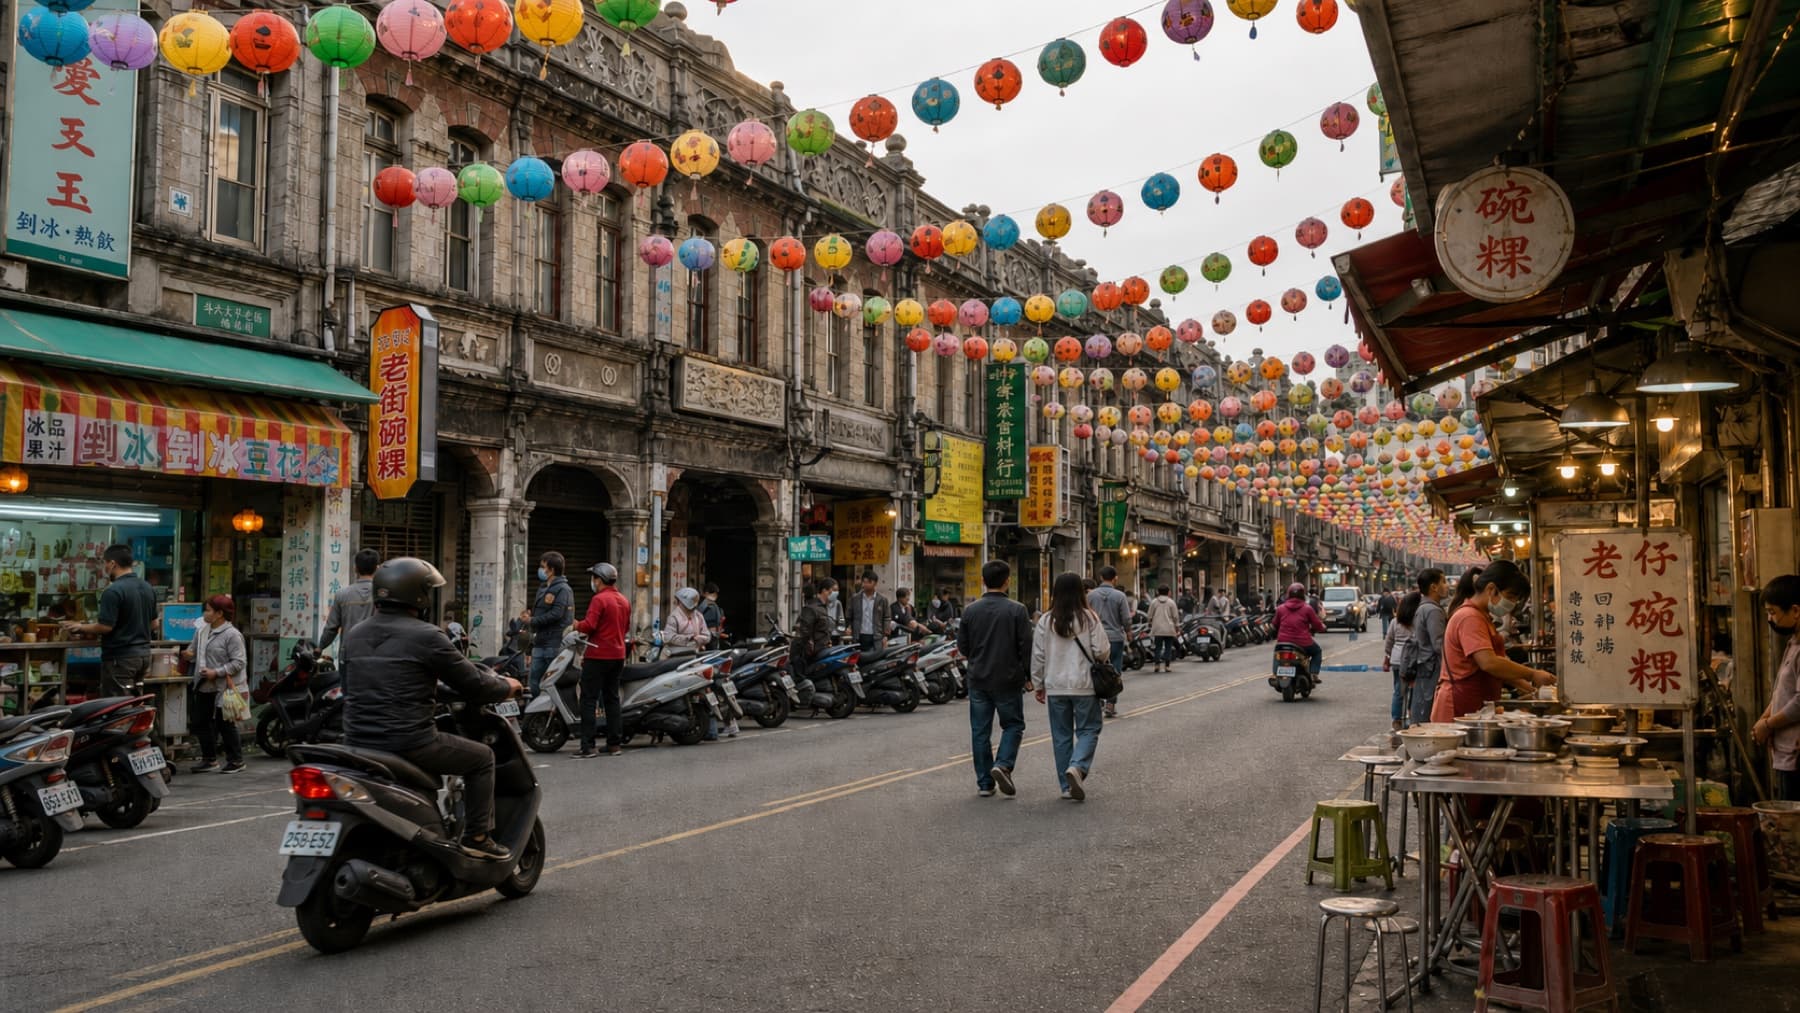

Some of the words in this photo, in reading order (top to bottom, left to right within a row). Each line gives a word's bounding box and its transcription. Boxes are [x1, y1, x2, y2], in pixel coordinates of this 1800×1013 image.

[1475, 180, 1535, 280] 碗粿
[27, 416, 65, 437] 冰品
[377, 352, 409, 480] 老街碗粿
[27, 439, 65, 460] 果汁
